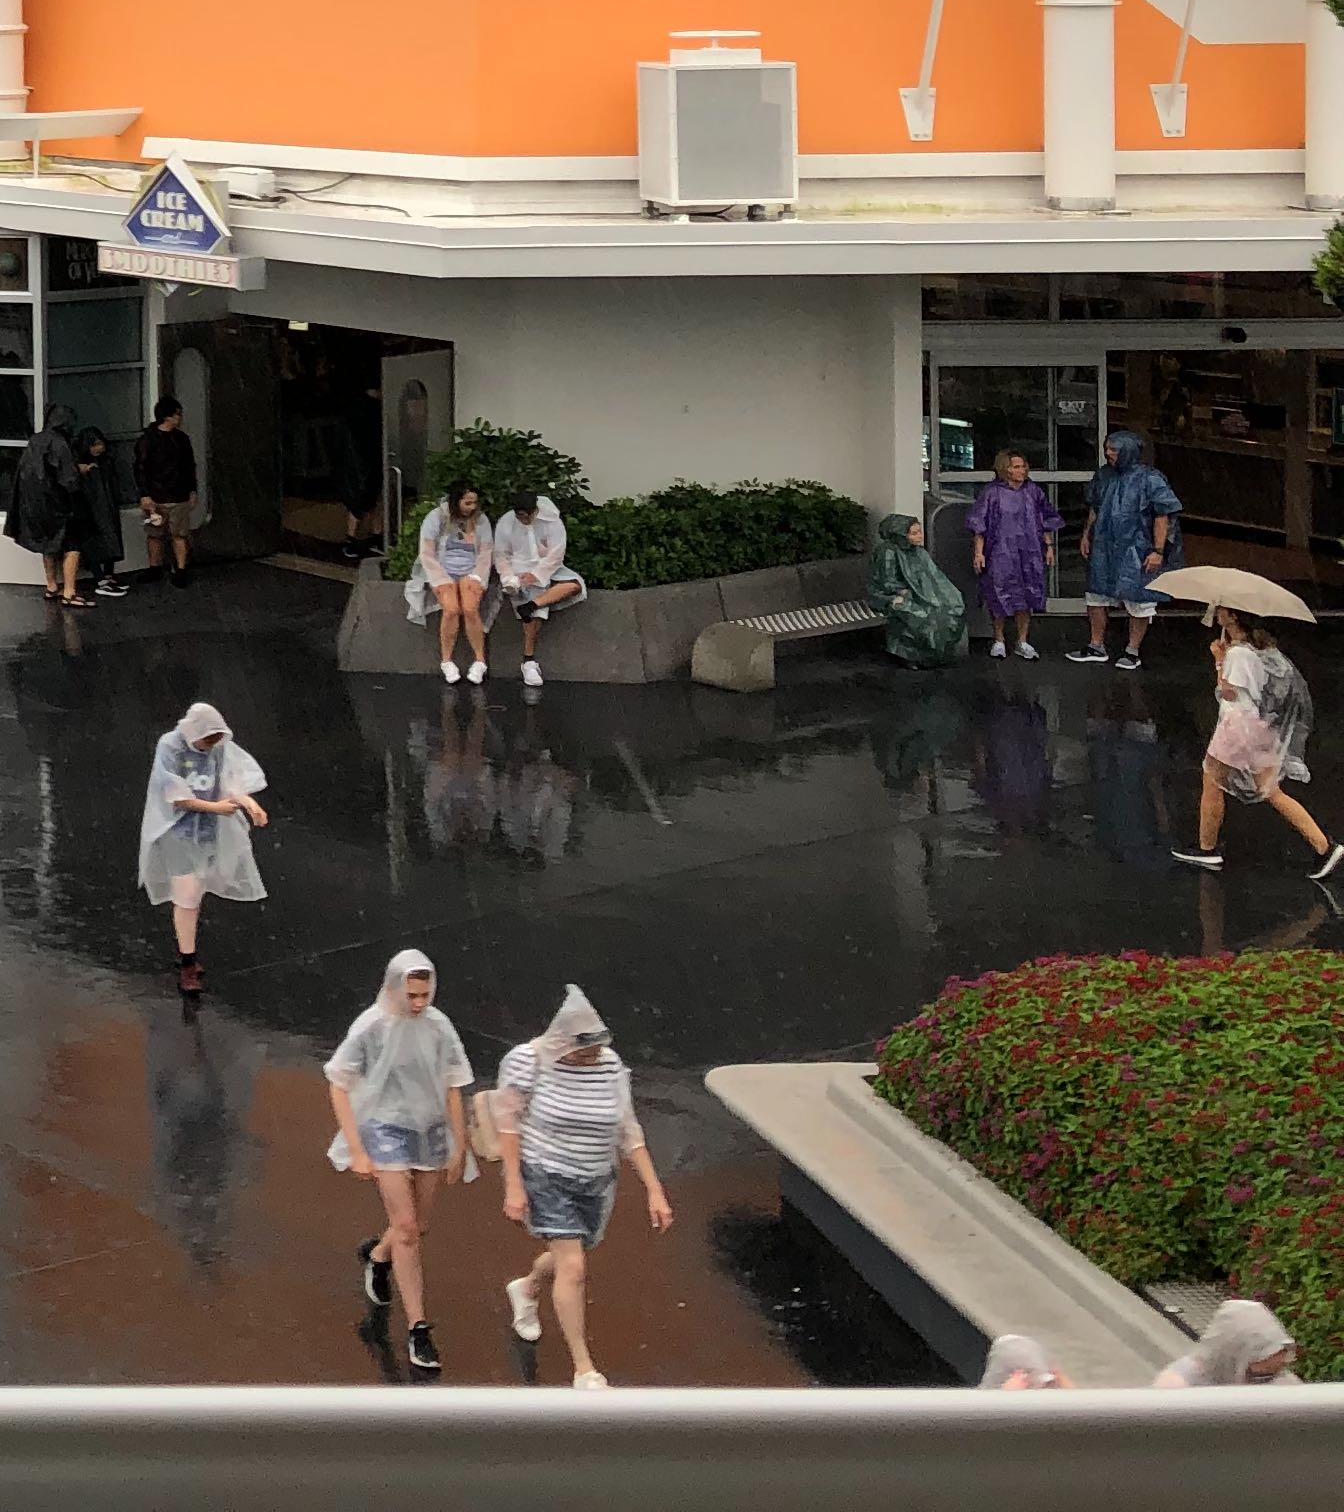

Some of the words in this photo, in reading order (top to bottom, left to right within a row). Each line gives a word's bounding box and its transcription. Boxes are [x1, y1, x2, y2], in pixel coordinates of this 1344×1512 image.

[156, 191, 187, 210] ICE
[140, 208, 204, 233] CREAM
[101, 248, 231, 284] SMOOTHIES
